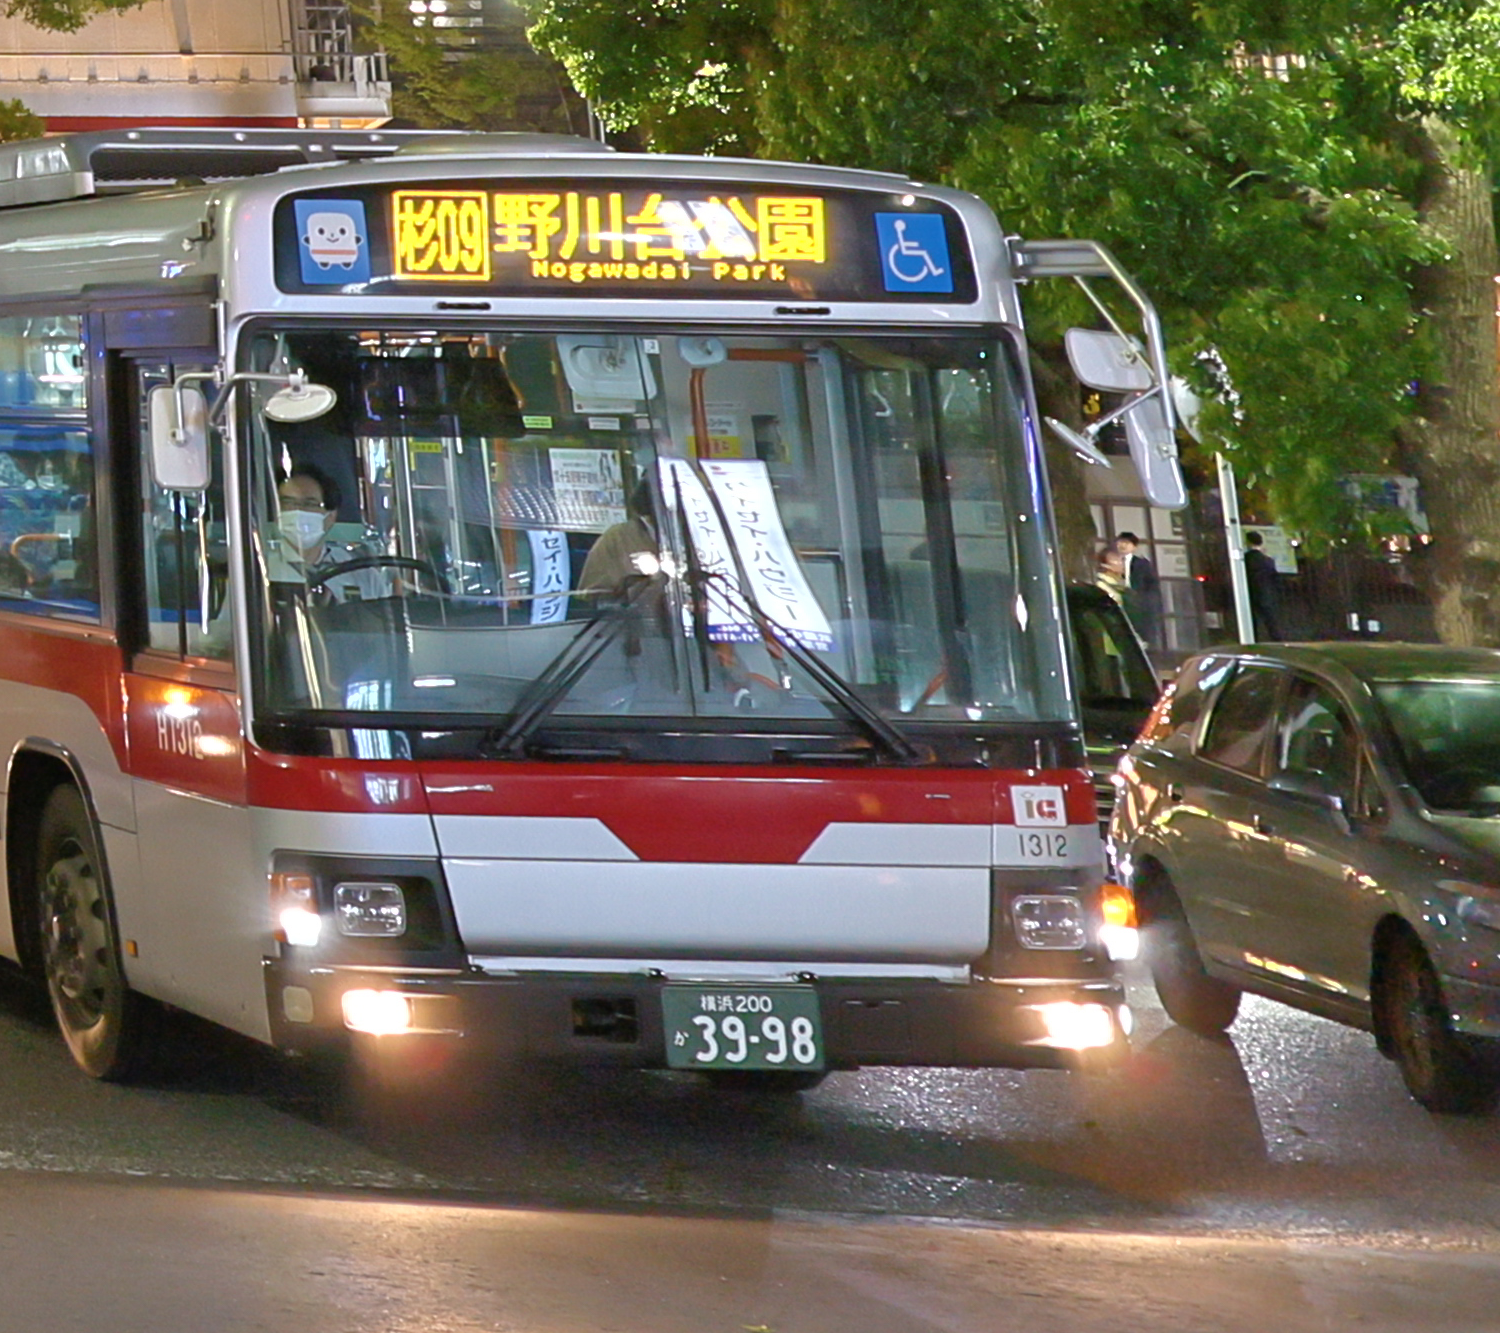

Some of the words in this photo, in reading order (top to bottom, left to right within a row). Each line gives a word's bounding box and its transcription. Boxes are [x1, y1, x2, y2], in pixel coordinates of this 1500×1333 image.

[400, 197, 485, 274] 杉09
[493, 191, 827, 265] 野川台公園
[531, 260, 692, 284] Nogawadai
[713, 262, 787, 283] Park
[1017, 833, 1069, 859] 1312
[699, 994, 773, 1014] 横浜200
[673, 1029, 690, 1049] か
[691, 1014, 818, 1065] 39-98
